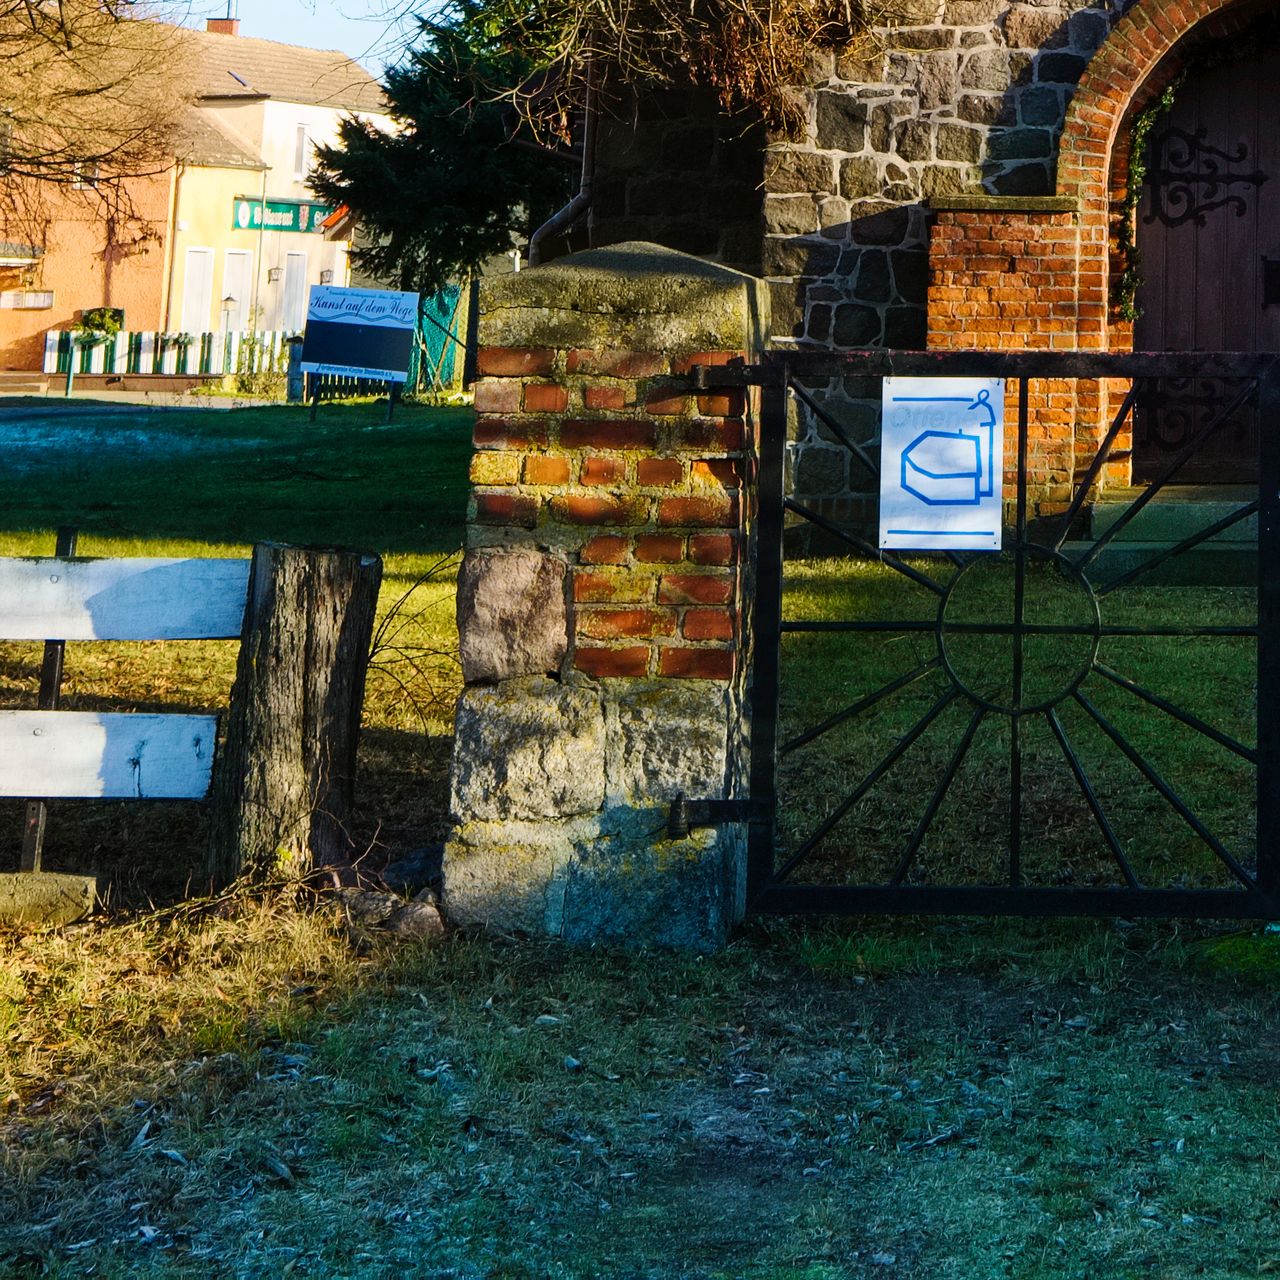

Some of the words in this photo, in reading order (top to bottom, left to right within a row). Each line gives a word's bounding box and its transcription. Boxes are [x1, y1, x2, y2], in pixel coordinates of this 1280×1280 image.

[310, 295, 346, 310] Kunst
[345, 297, 366, 317] auf
[365, 299, 386, 314] dem
